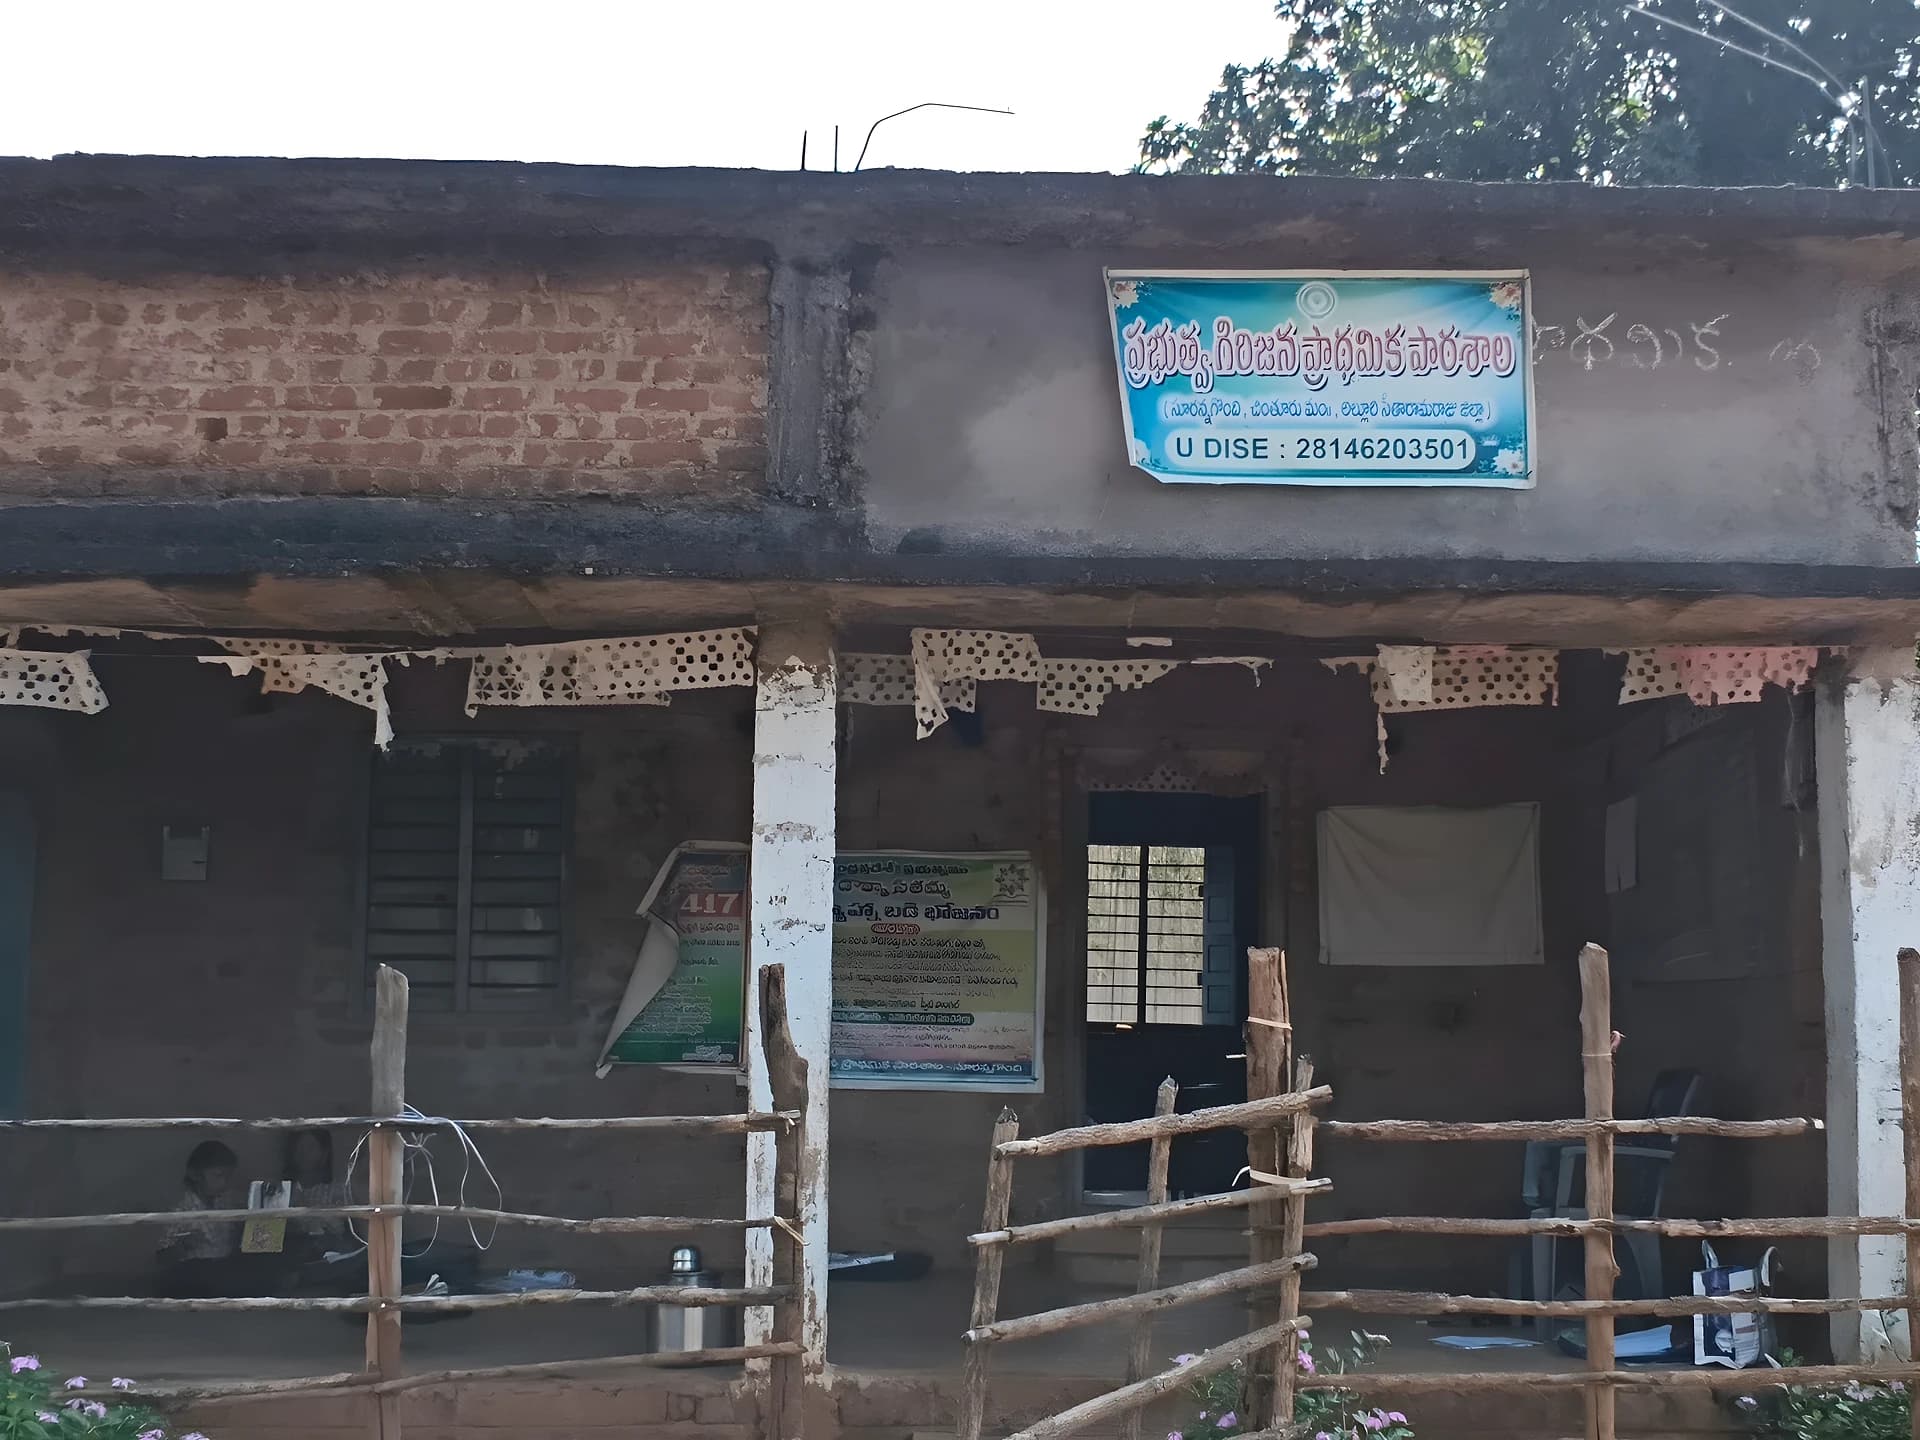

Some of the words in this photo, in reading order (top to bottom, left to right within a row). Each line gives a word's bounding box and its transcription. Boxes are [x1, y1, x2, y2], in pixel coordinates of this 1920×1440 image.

[1125, 317, 1212, 390] ప్రభుత్వ
[1214, 318, 1300, 374] గిరిజన
[1176, 437, 1193, 458] U
[1204, 437, 1269, 459] DISE
[1296, 438, 1468, 460] 28146203501
[680, 893, 740, 914] 417
